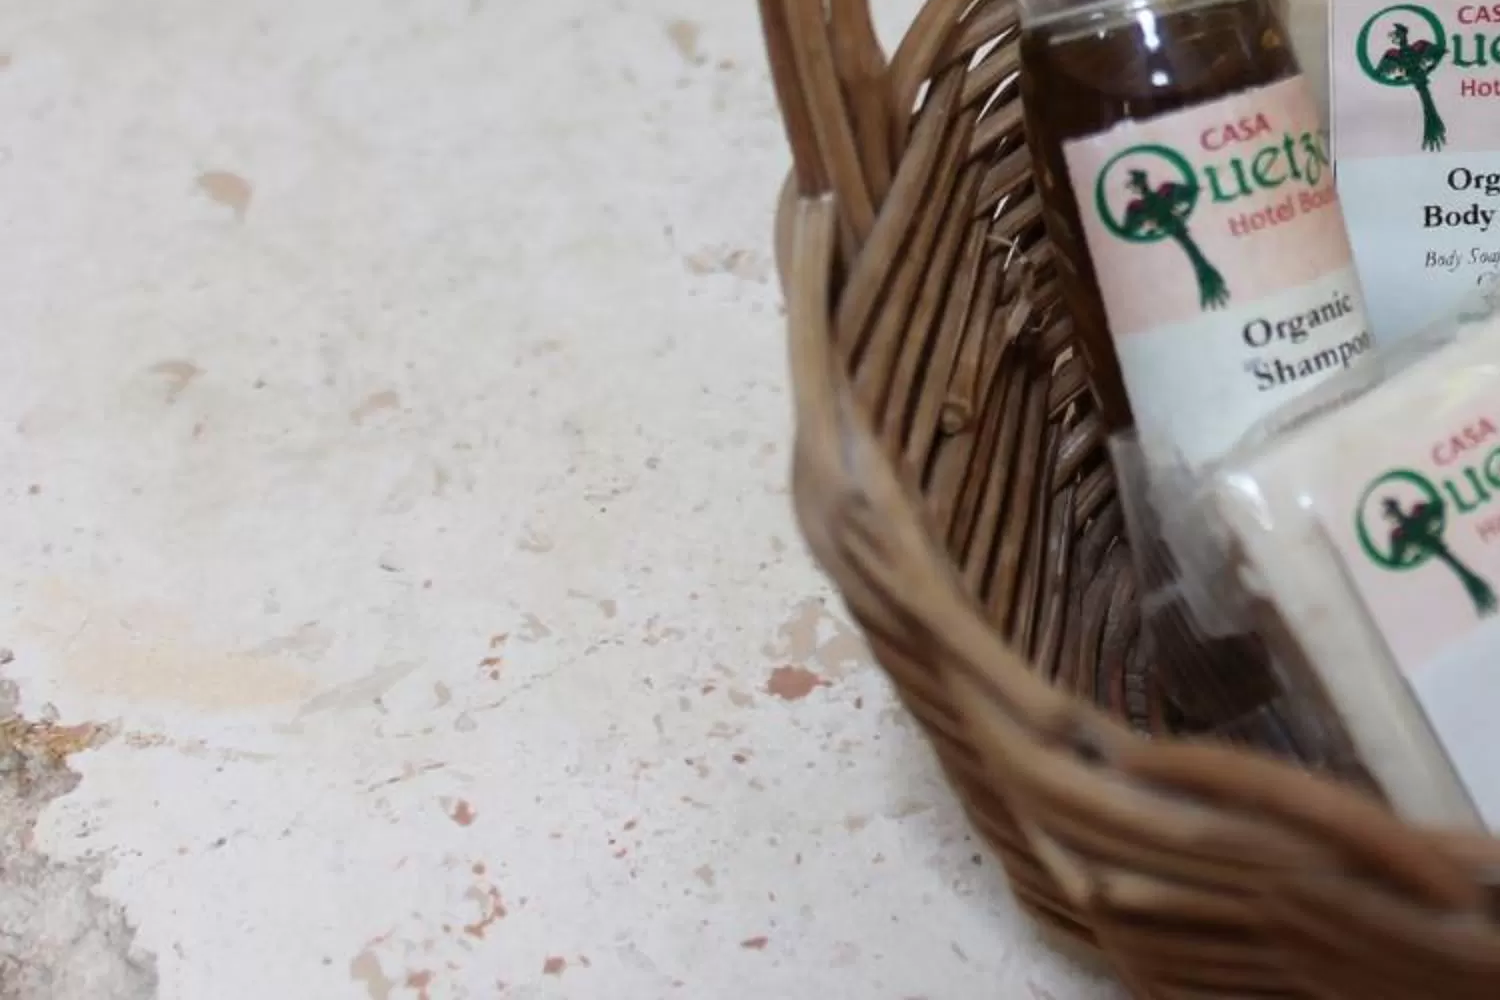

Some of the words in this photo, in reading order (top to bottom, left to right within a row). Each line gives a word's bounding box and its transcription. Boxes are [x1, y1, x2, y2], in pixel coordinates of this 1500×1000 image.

[1200, 112, 1272, 151] CASA
[1228, 194, 1295, 236] Hotel
[1423, 203, 1497, 232] Body
[1425, 250, 1461, 273] Body
[1242, 290, 1353, 347] Organic
[1431, 416, 1498, 467] CASA
